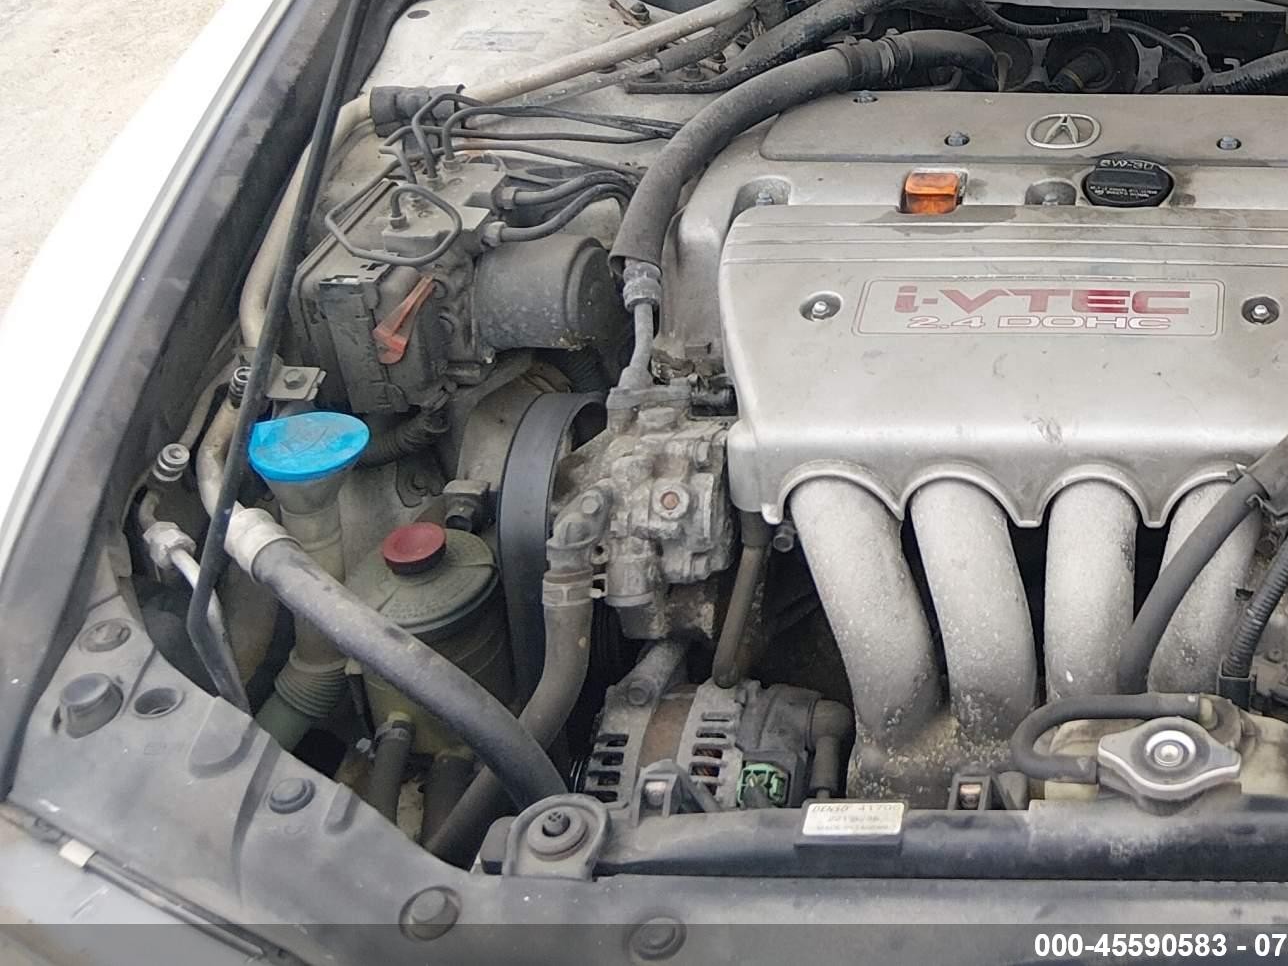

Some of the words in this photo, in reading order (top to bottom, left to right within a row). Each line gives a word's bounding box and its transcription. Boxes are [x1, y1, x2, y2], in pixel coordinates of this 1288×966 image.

[1099, 159, 1154, 170] 5W-30
[894, 285, 1191, 315] i-VTEC
[906, 315, 986, 329] 2.4
[997, 316, 1173, 330] DOHC
